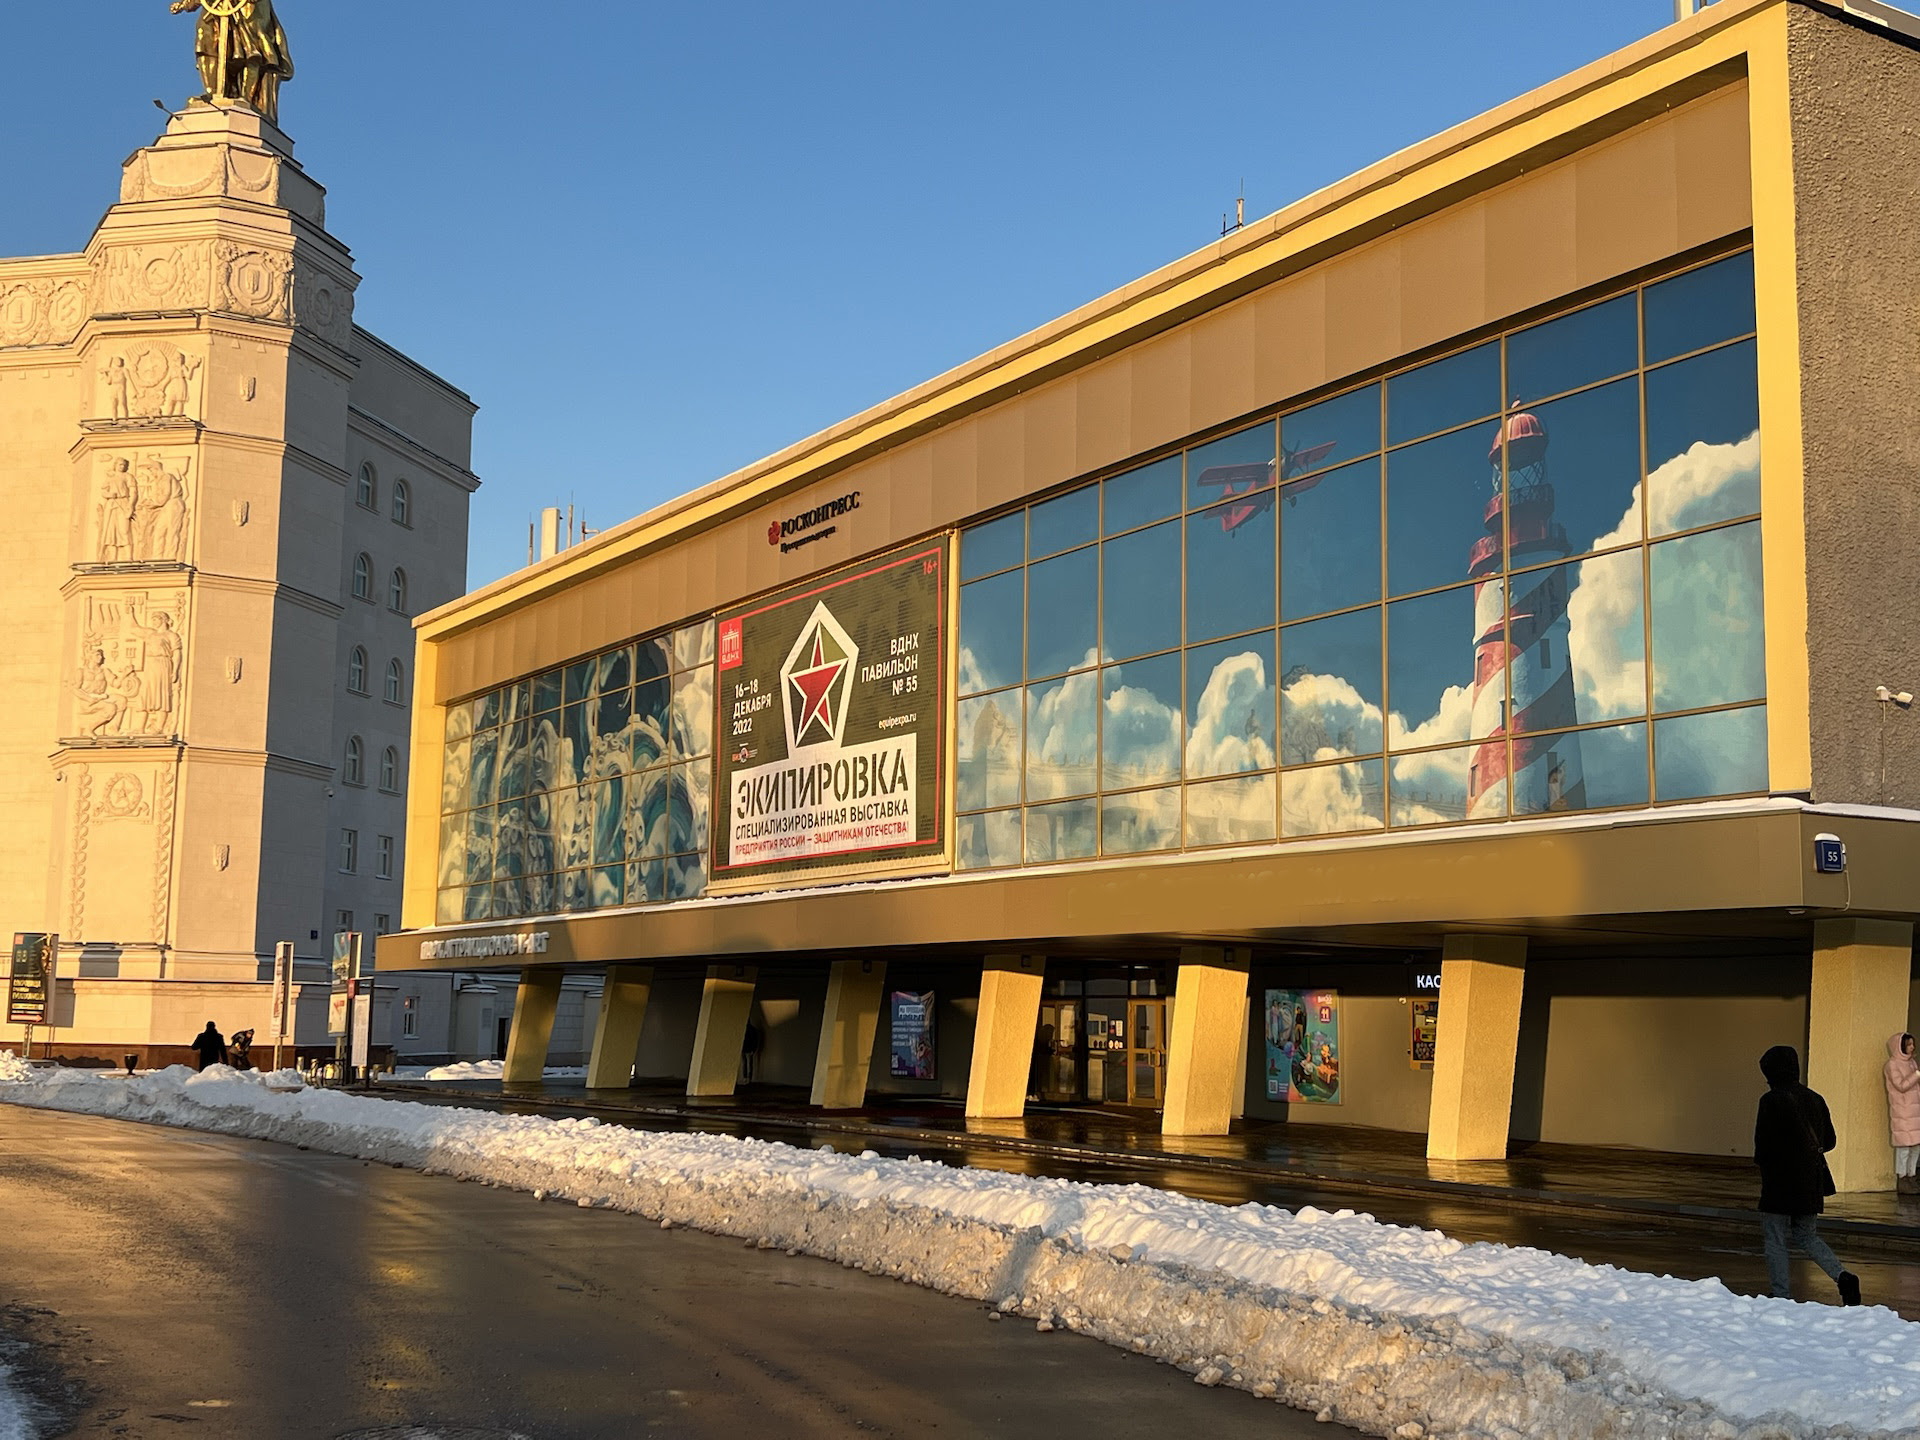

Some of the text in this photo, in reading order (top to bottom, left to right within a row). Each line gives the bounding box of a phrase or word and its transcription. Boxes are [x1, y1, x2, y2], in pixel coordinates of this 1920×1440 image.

[780, 491, 860, 537] РОСКОНГРЕСС
[922, 559, 938, 575] 16+
[890, 632, 919, 656] ВДНХ
[721, 652, 740, 665] ВДНХ
[861, 653, 918, 683] ПАВИЛЬОН
[892, 675, 918, 697] № 55
[732, 693, 772, 720] ДЕКАБРЯ
[732, 718, 753, 736] 2022
[878, 712, 917, 730] equipexpo.ru
[736, 748, 909, 820] ЭКИПИРОВКА
[735, 798, 909, 841] СПЕЦИАЛИЗИРОВАННАЯ ВЫСТАВКА
[735, 840, 778, 856] ПРЕДПРИЯТИЯ
[779, 835, 806, 850] РОССИИ
[813, 829, 864, 845] ЗАЩИТНИКАМ
[1828, 851, 1838, 862] 55
